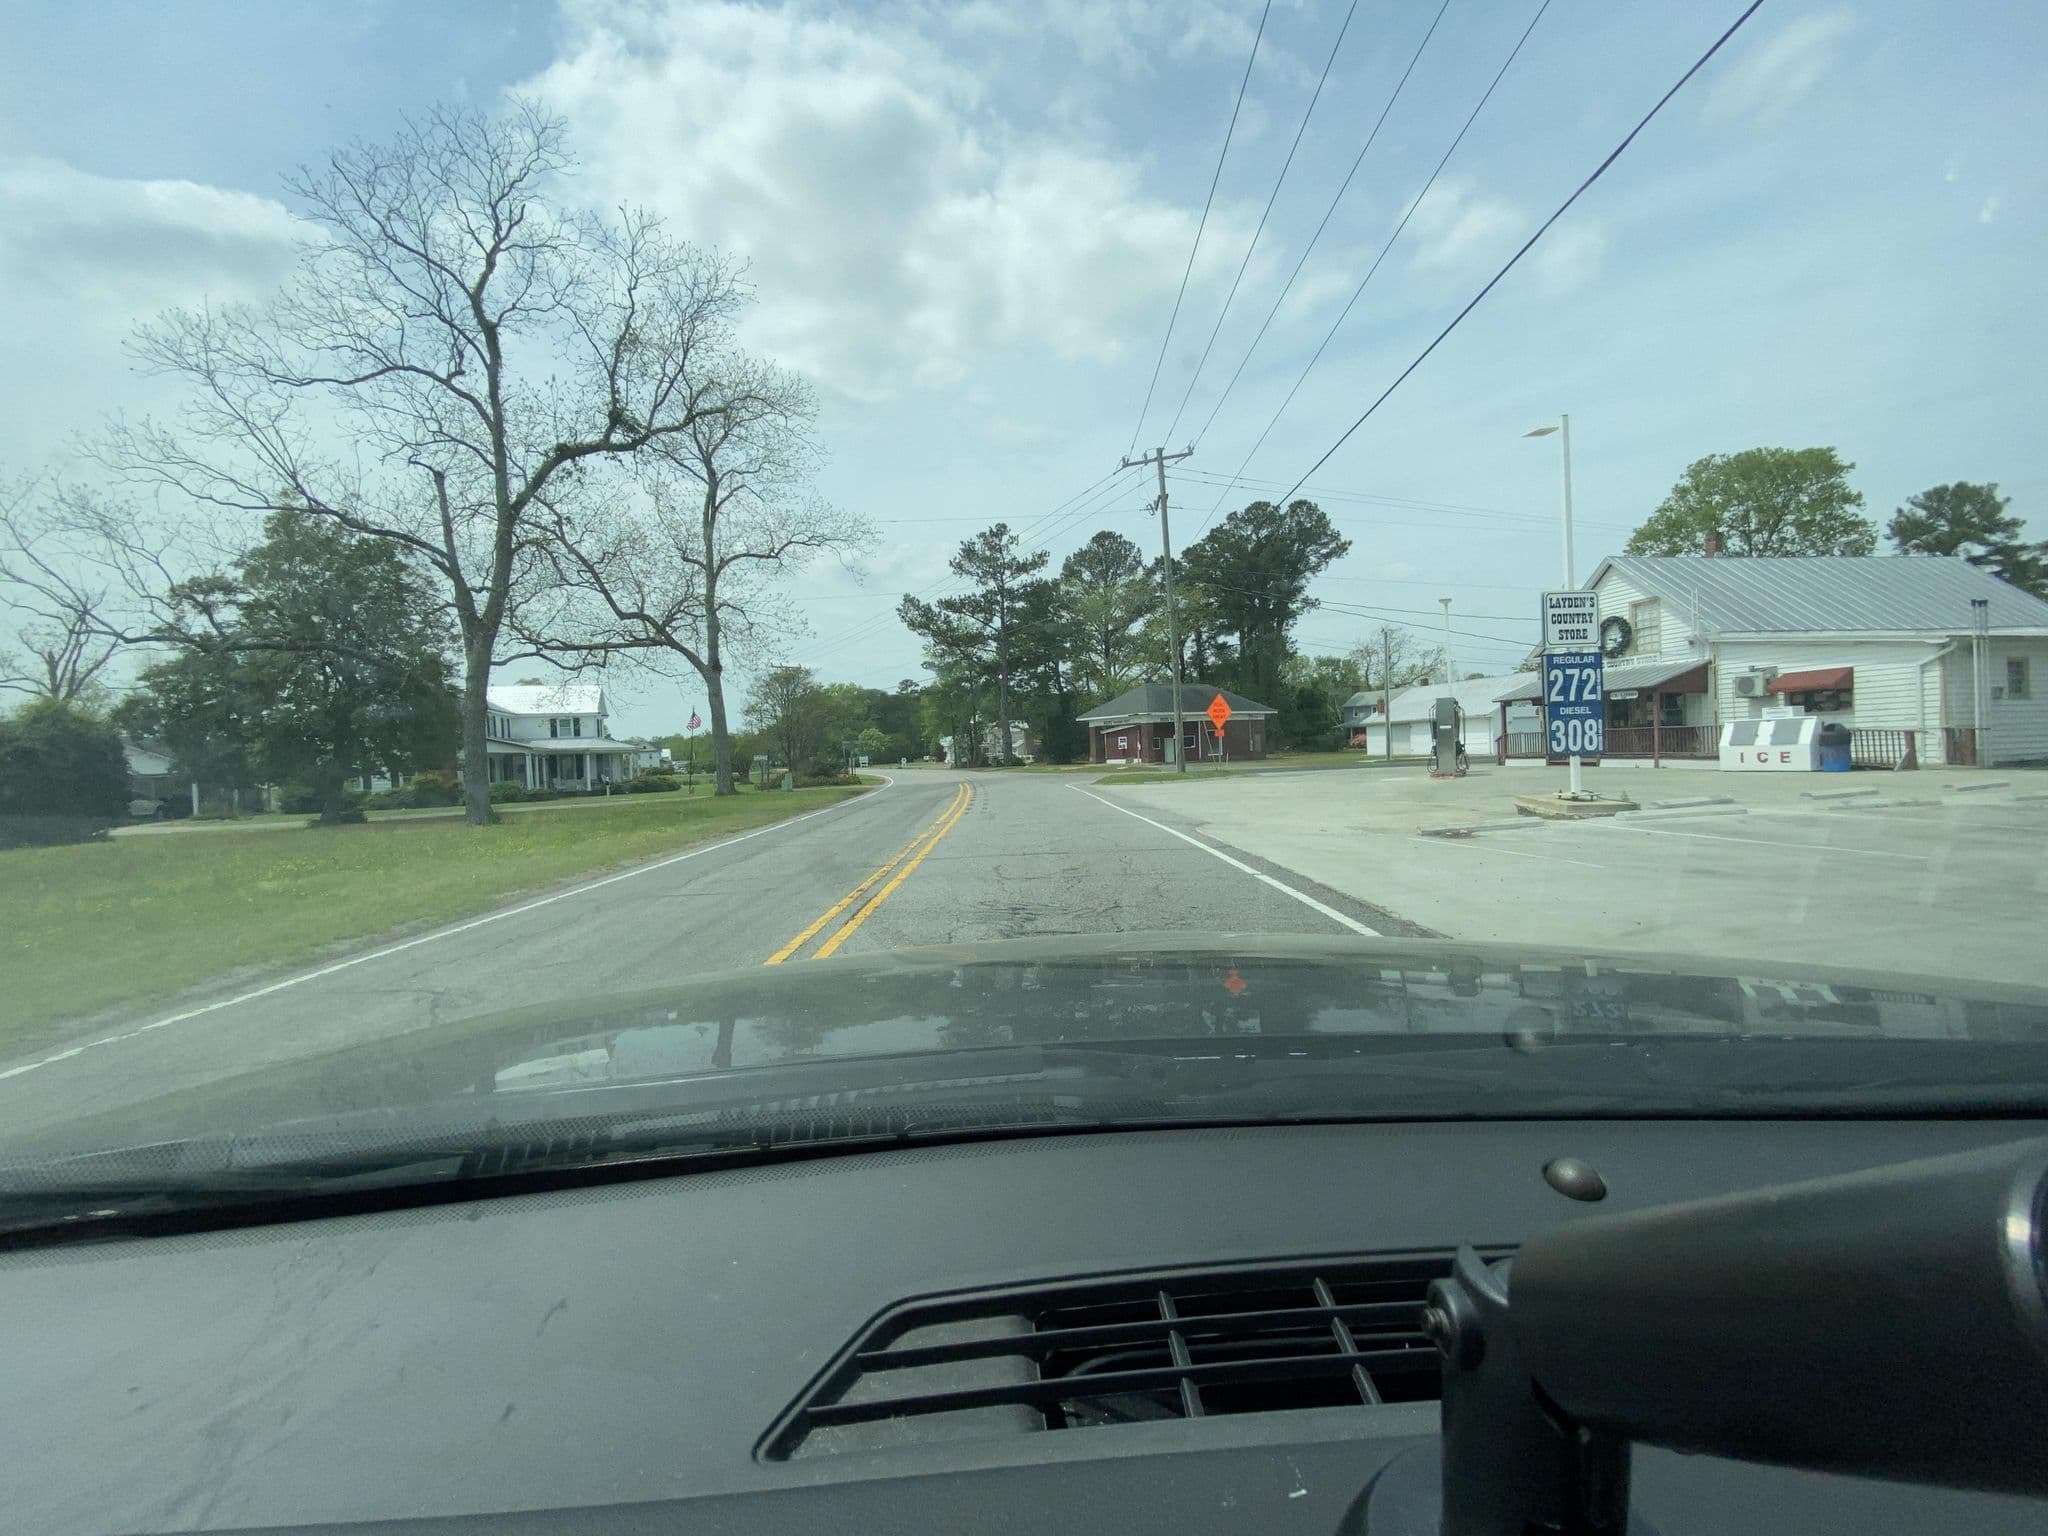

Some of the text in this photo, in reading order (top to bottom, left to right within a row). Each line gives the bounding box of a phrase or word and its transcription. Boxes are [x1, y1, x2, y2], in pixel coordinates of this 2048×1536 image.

[1549, 597, 1595, 608] LAYDEN'S
[1551, 613, 1594, 624] COUNTRY
[1558, 629, 1588, 640] STORE
[1553, 656, 1595, 664] REGULAR
[1549, 668, 1596, 701] 272
[1560, 706, 1592, 715] DIESEL
[1551, 719, 1598, 752] 308
[1740, 751, 1792, 763] ICE
